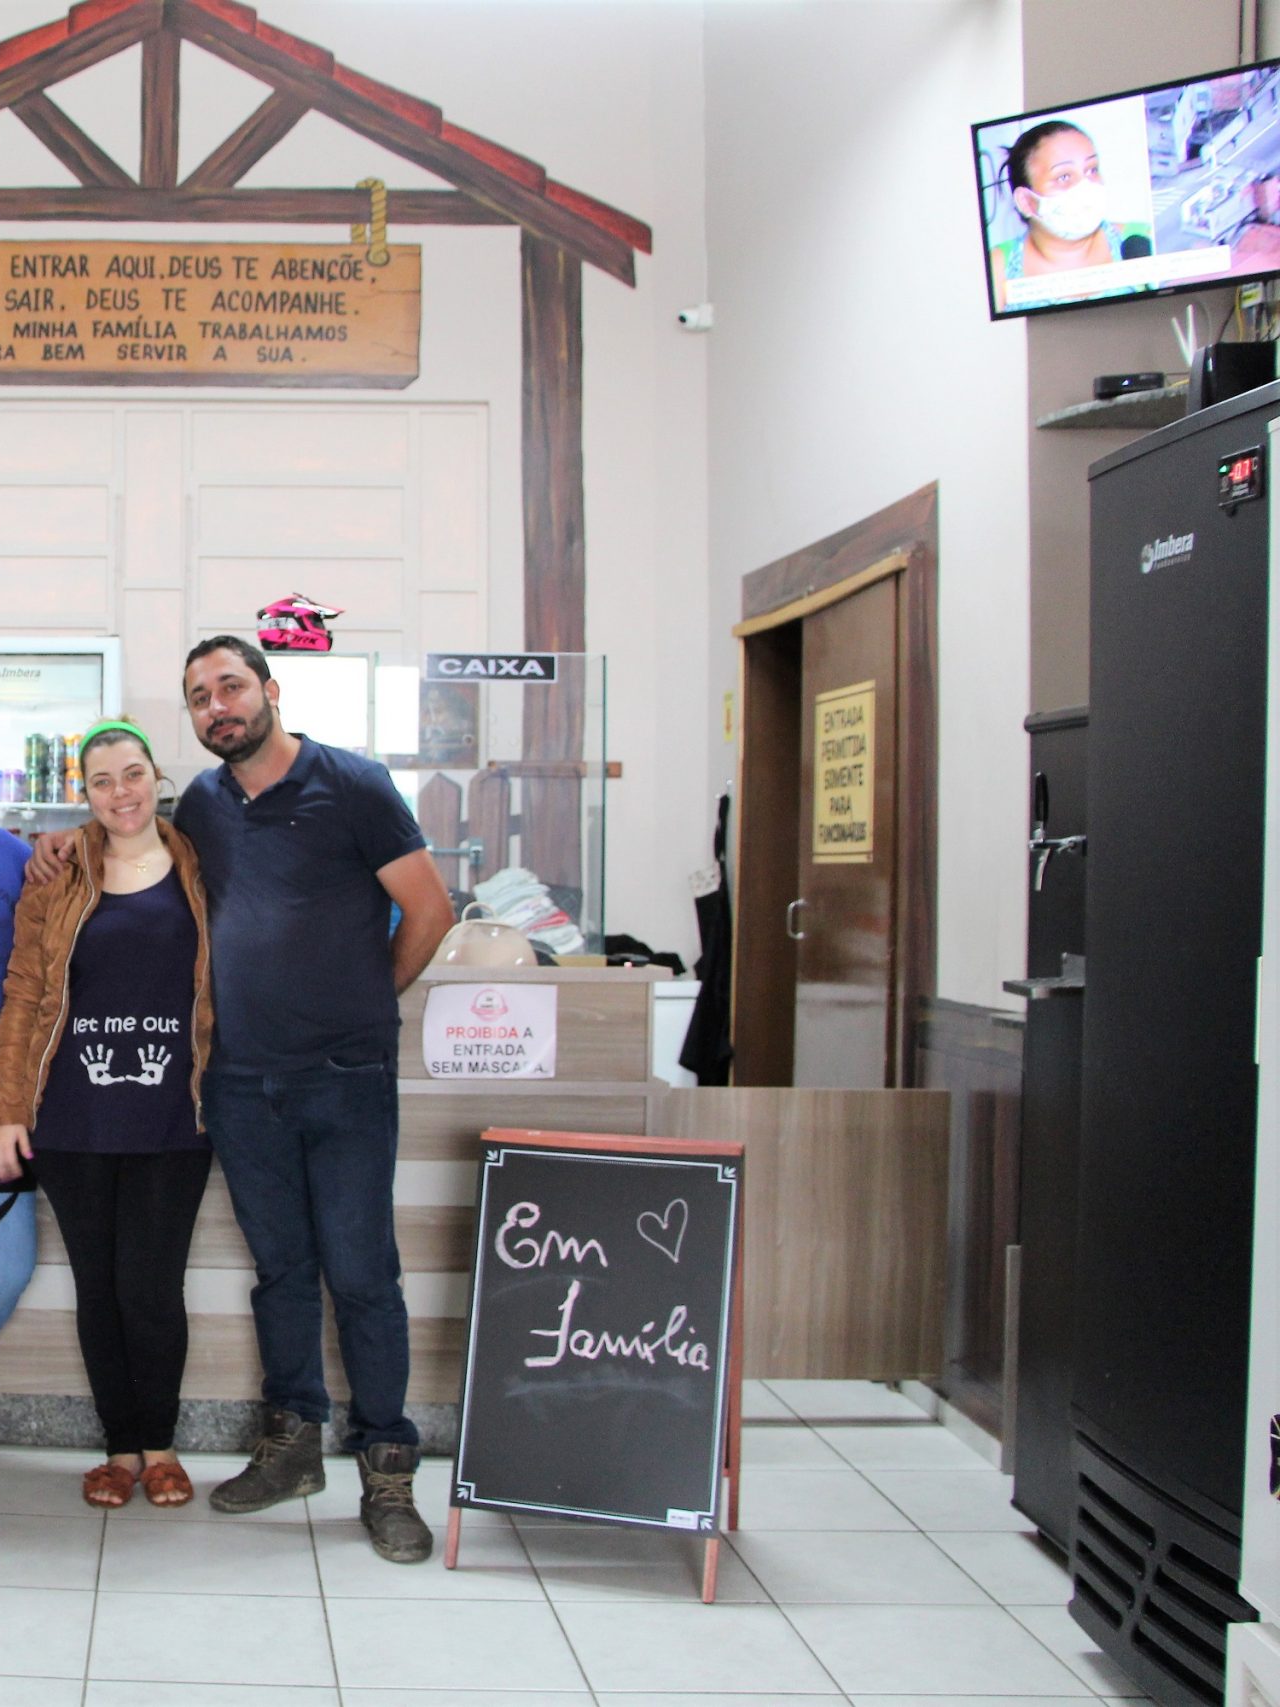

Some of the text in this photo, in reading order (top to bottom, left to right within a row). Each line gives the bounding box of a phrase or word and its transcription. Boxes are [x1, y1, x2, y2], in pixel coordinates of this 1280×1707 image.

[10, 255, 89, 278] ENTRAR
[232, 256, 259, 280] TE
[85, 288, 140, 311] DEUS
[162, 288, 187, 312] TE
[12, 321, 78, 339] MINHA
[92, 315, 177, 339] FAMÍLIA
[199, 321, 348, 341] TRABALHAMOS
[41, 344, 85, 361] BEM
[117, 344, 187, 361] SERVIR
[213, 345, 227, 362] A
[1154, 532, 1195, 562] Imbera
[438, 658, 545, 676] CAIXA
[824, 705, 863, 733] ENTRADA
[822, 733, 867, 762] PERMITIDA
[824, 763, 864, 790] SOMENTE
[829, 795, 852, 815] PARA
[73, 1016, 179, 1035] let me out
[446, 1027, 533, 1039] PROIBIDA A
[453, 1044, 526, 1056] ENTRADA
[432, 1061, 463, 1074] SEM
[495, 1201, 609, 1269] Em
